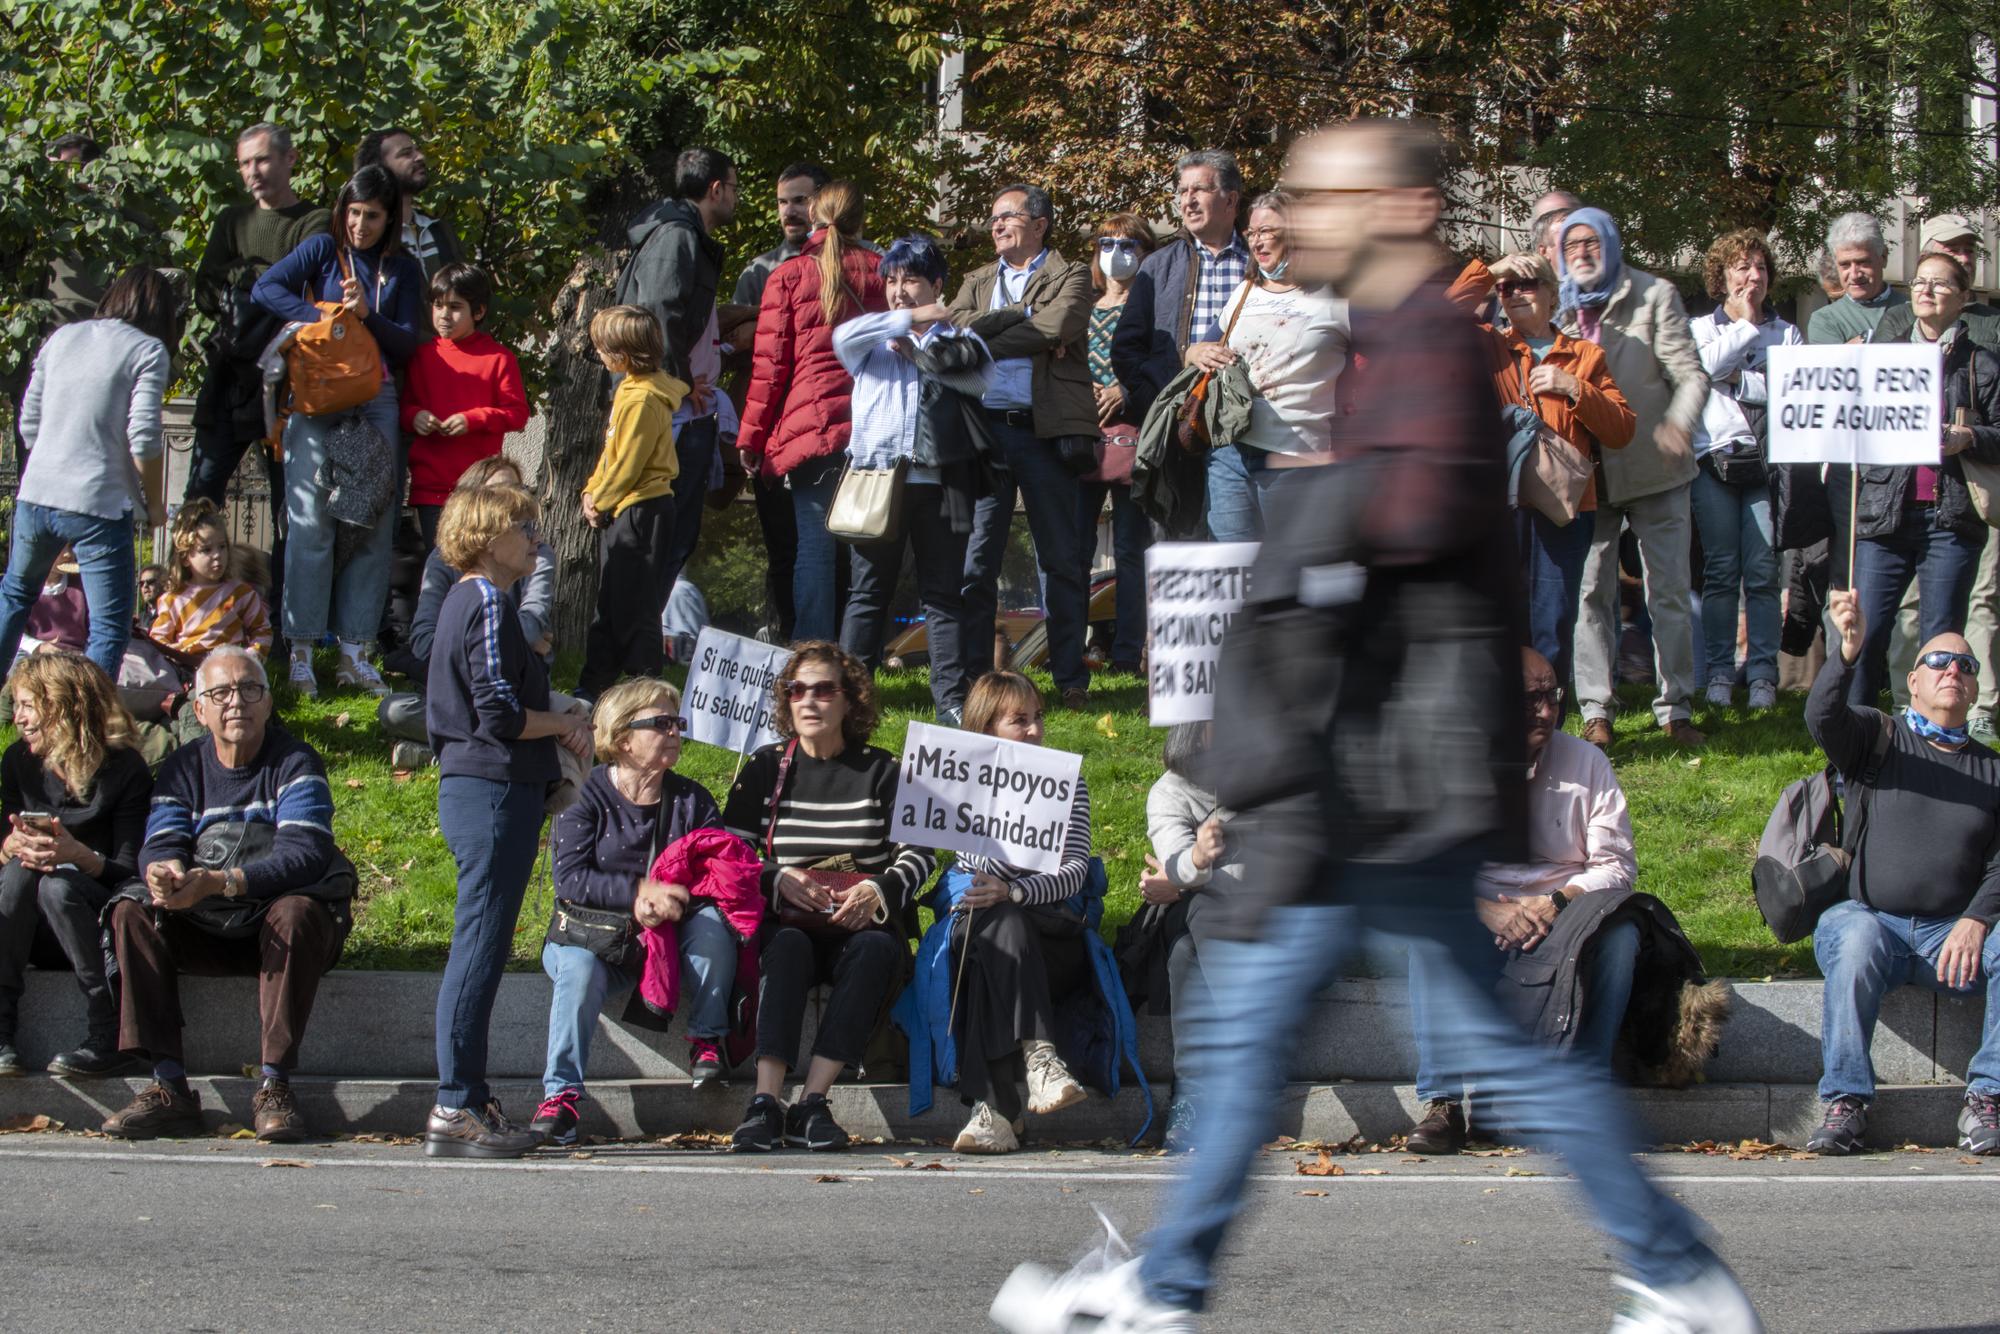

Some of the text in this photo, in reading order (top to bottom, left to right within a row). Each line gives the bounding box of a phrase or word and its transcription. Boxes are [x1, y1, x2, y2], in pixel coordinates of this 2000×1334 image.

[1781, 367, 1932, 397] ¡AYUSO, PEOR
[1781, 404, 1931, 432] QUE AGUIRRE!
[701, 647, 778, 691] Si me quita
[690, 685, 776, 734] tu salud pe
[906, 744, 1070, 805] ¡Más apoyos
[901, 797, 1064, 853] a la Sanidad!
